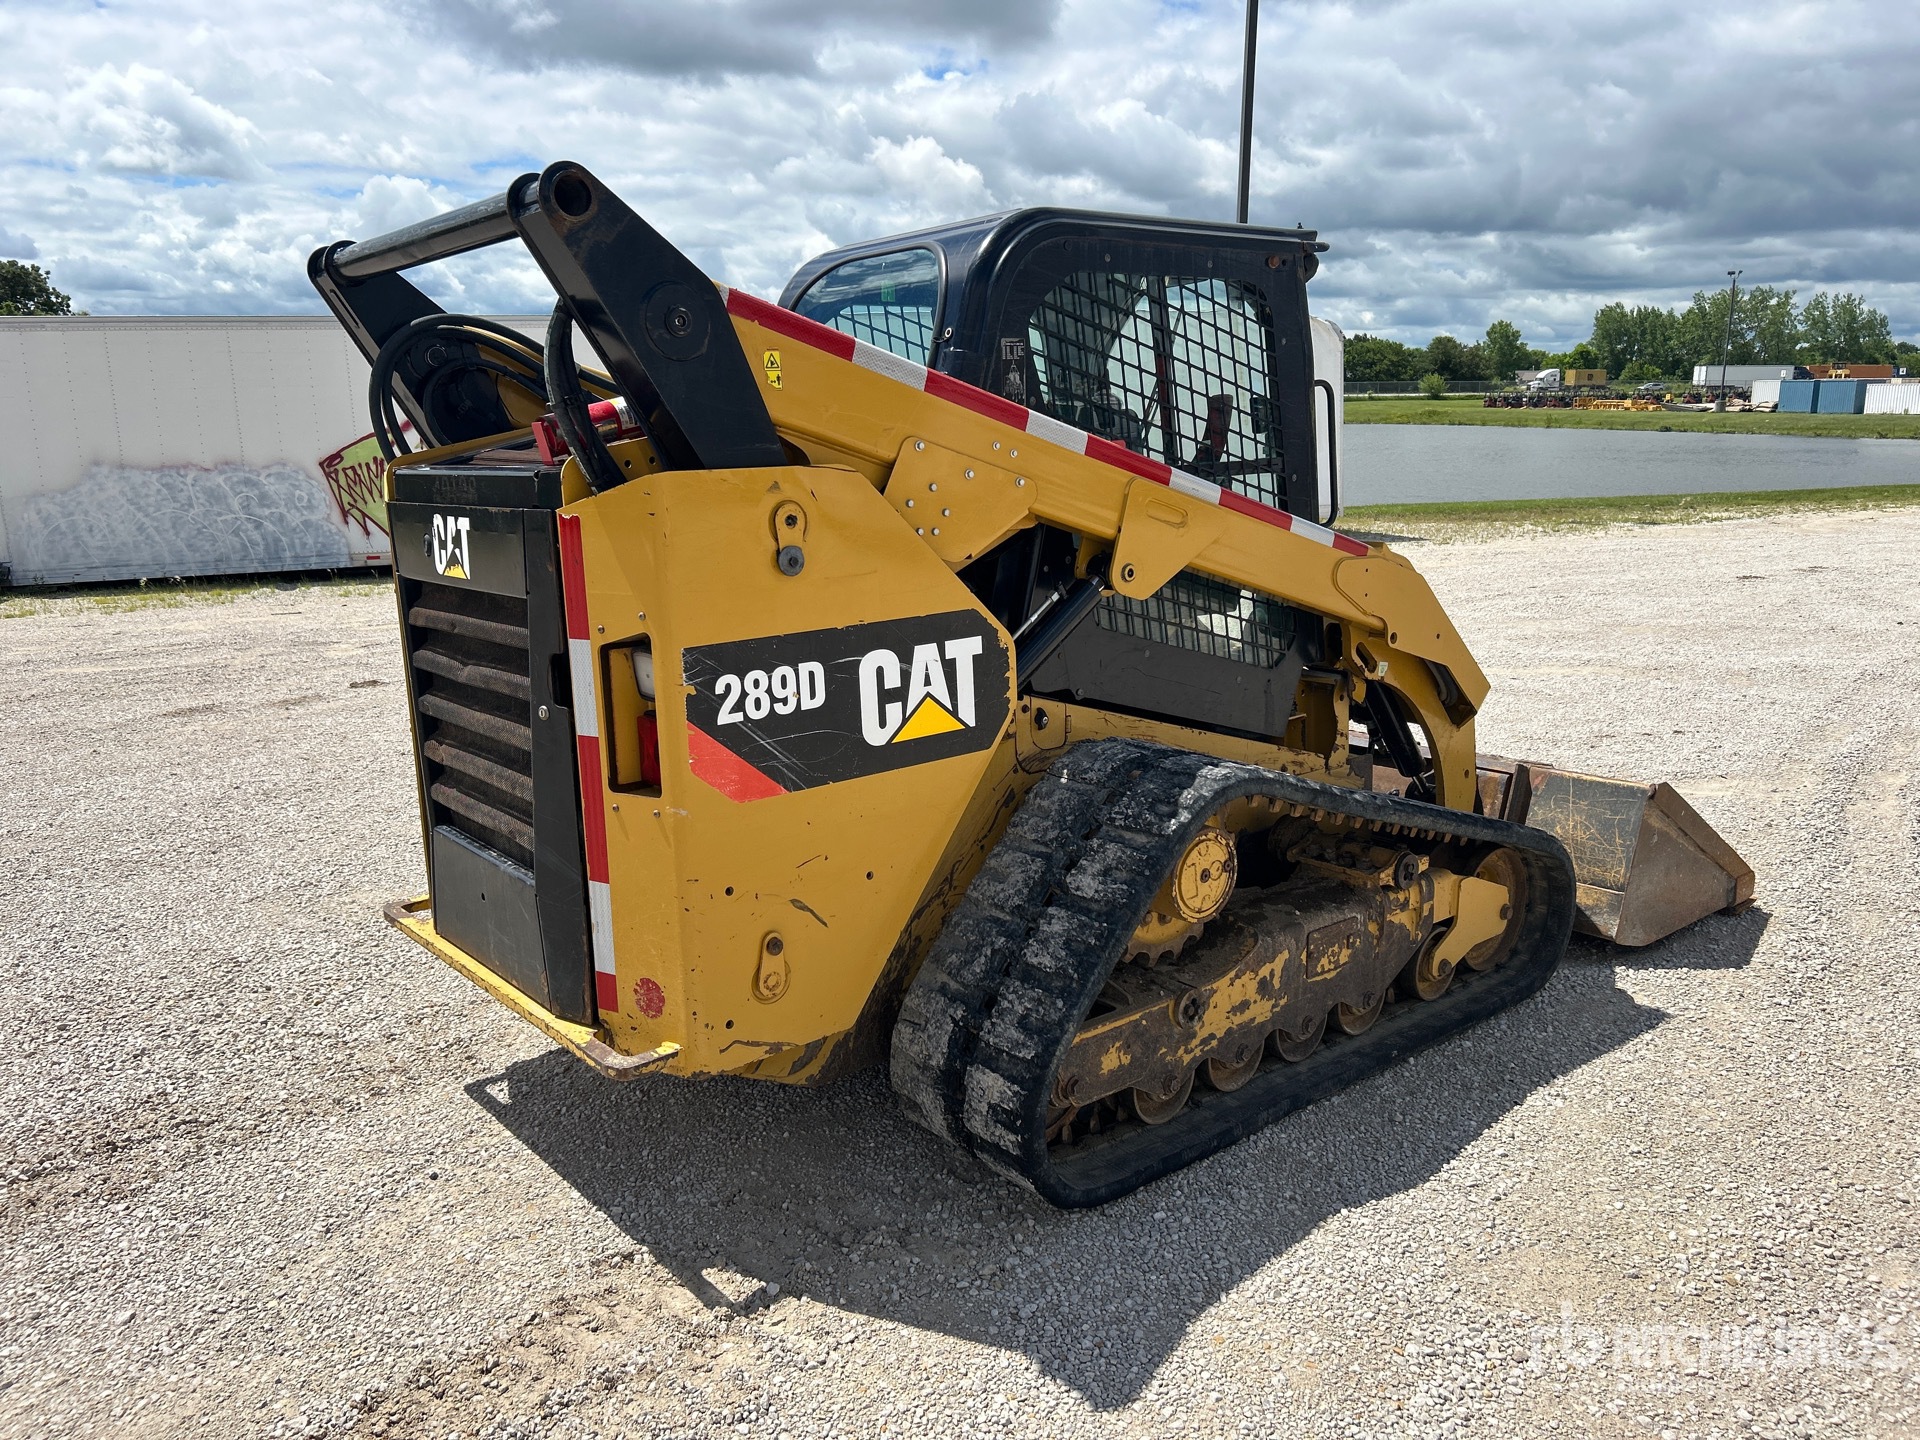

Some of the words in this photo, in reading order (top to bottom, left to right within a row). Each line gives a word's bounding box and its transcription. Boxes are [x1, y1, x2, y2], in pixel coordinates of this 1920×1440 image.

[432, 513, 471, 580] CAT
[714, 661, 826, 726] 289D
[858, 635, 983, 747] CAT
